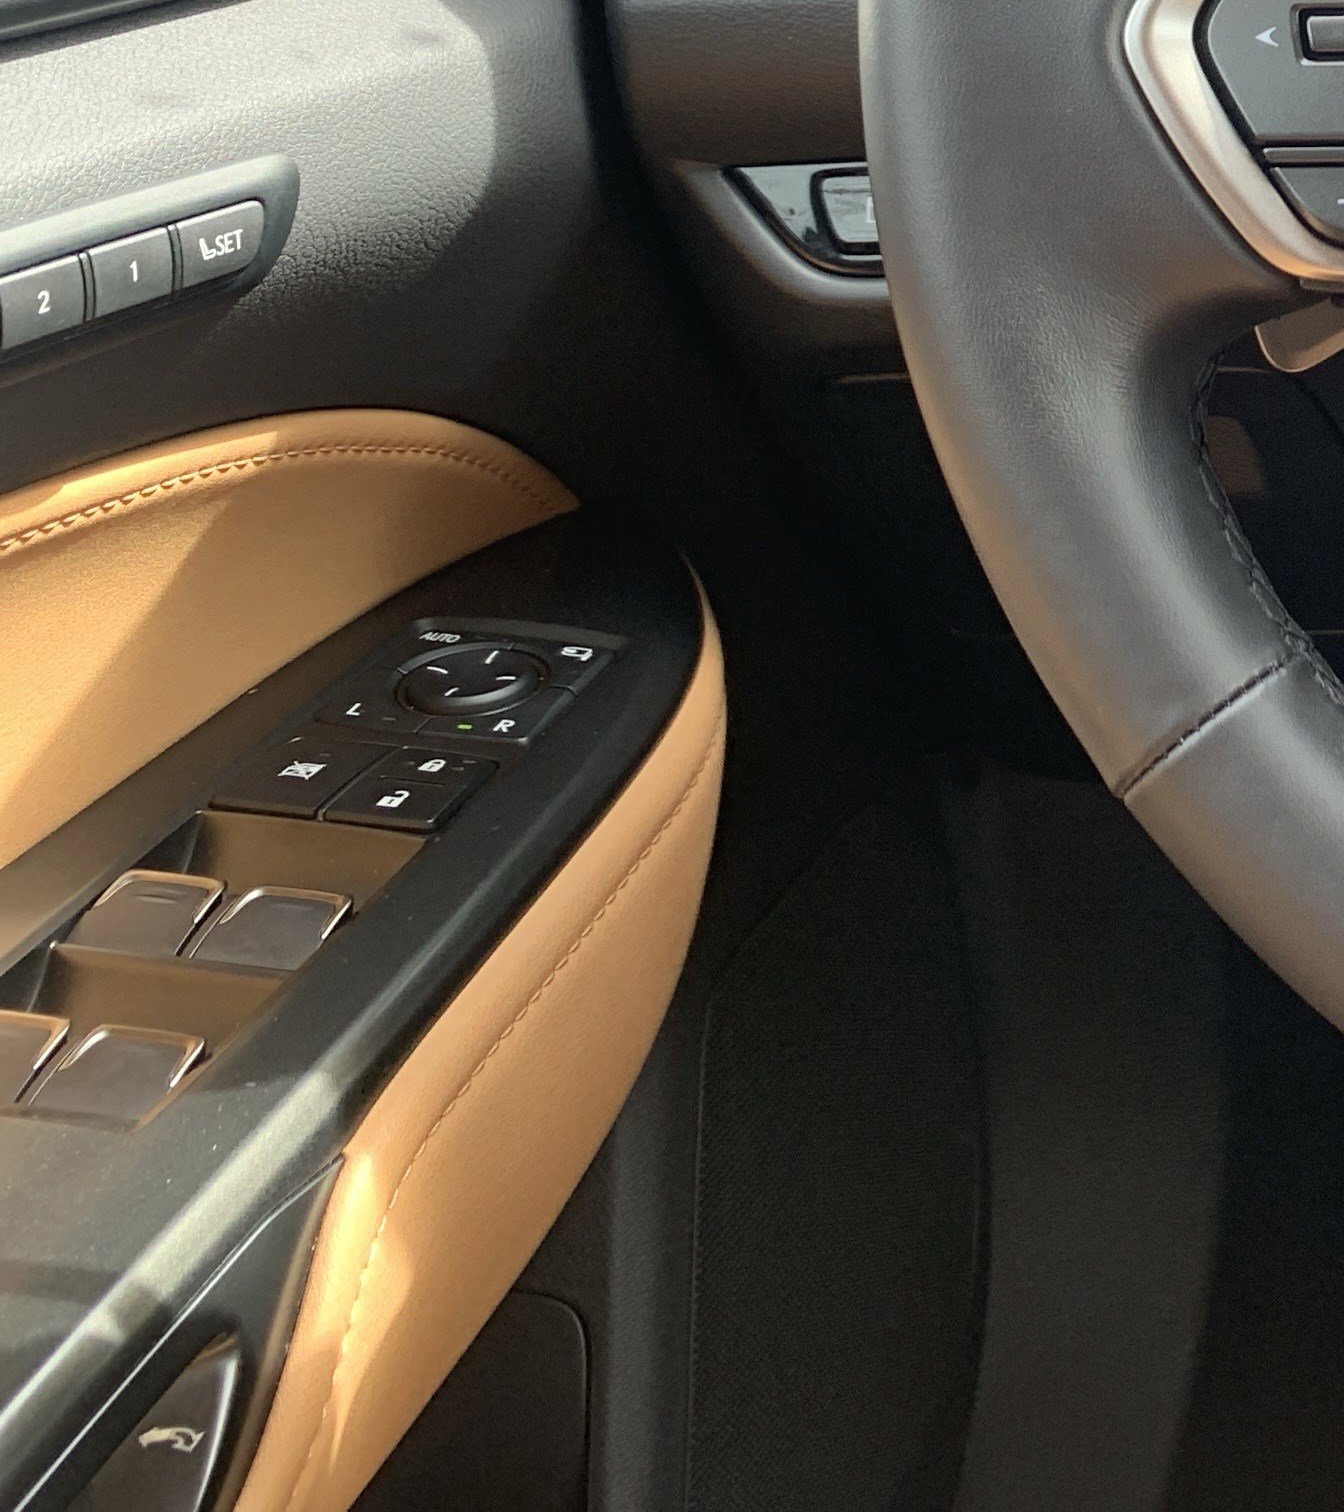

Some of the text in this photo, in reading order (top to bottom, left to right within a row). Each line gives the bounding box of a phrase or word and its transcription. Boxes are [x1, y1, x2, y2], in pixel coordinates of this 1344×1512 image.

[216, 228, 244, 256] SET
[129, 260, 139, 283] 1
[37, 290, 52, 315] 2
[419, 631, 461, 644] AUTO
[345, 702, 362, 716] L
[492, 719, 515, 733] R
